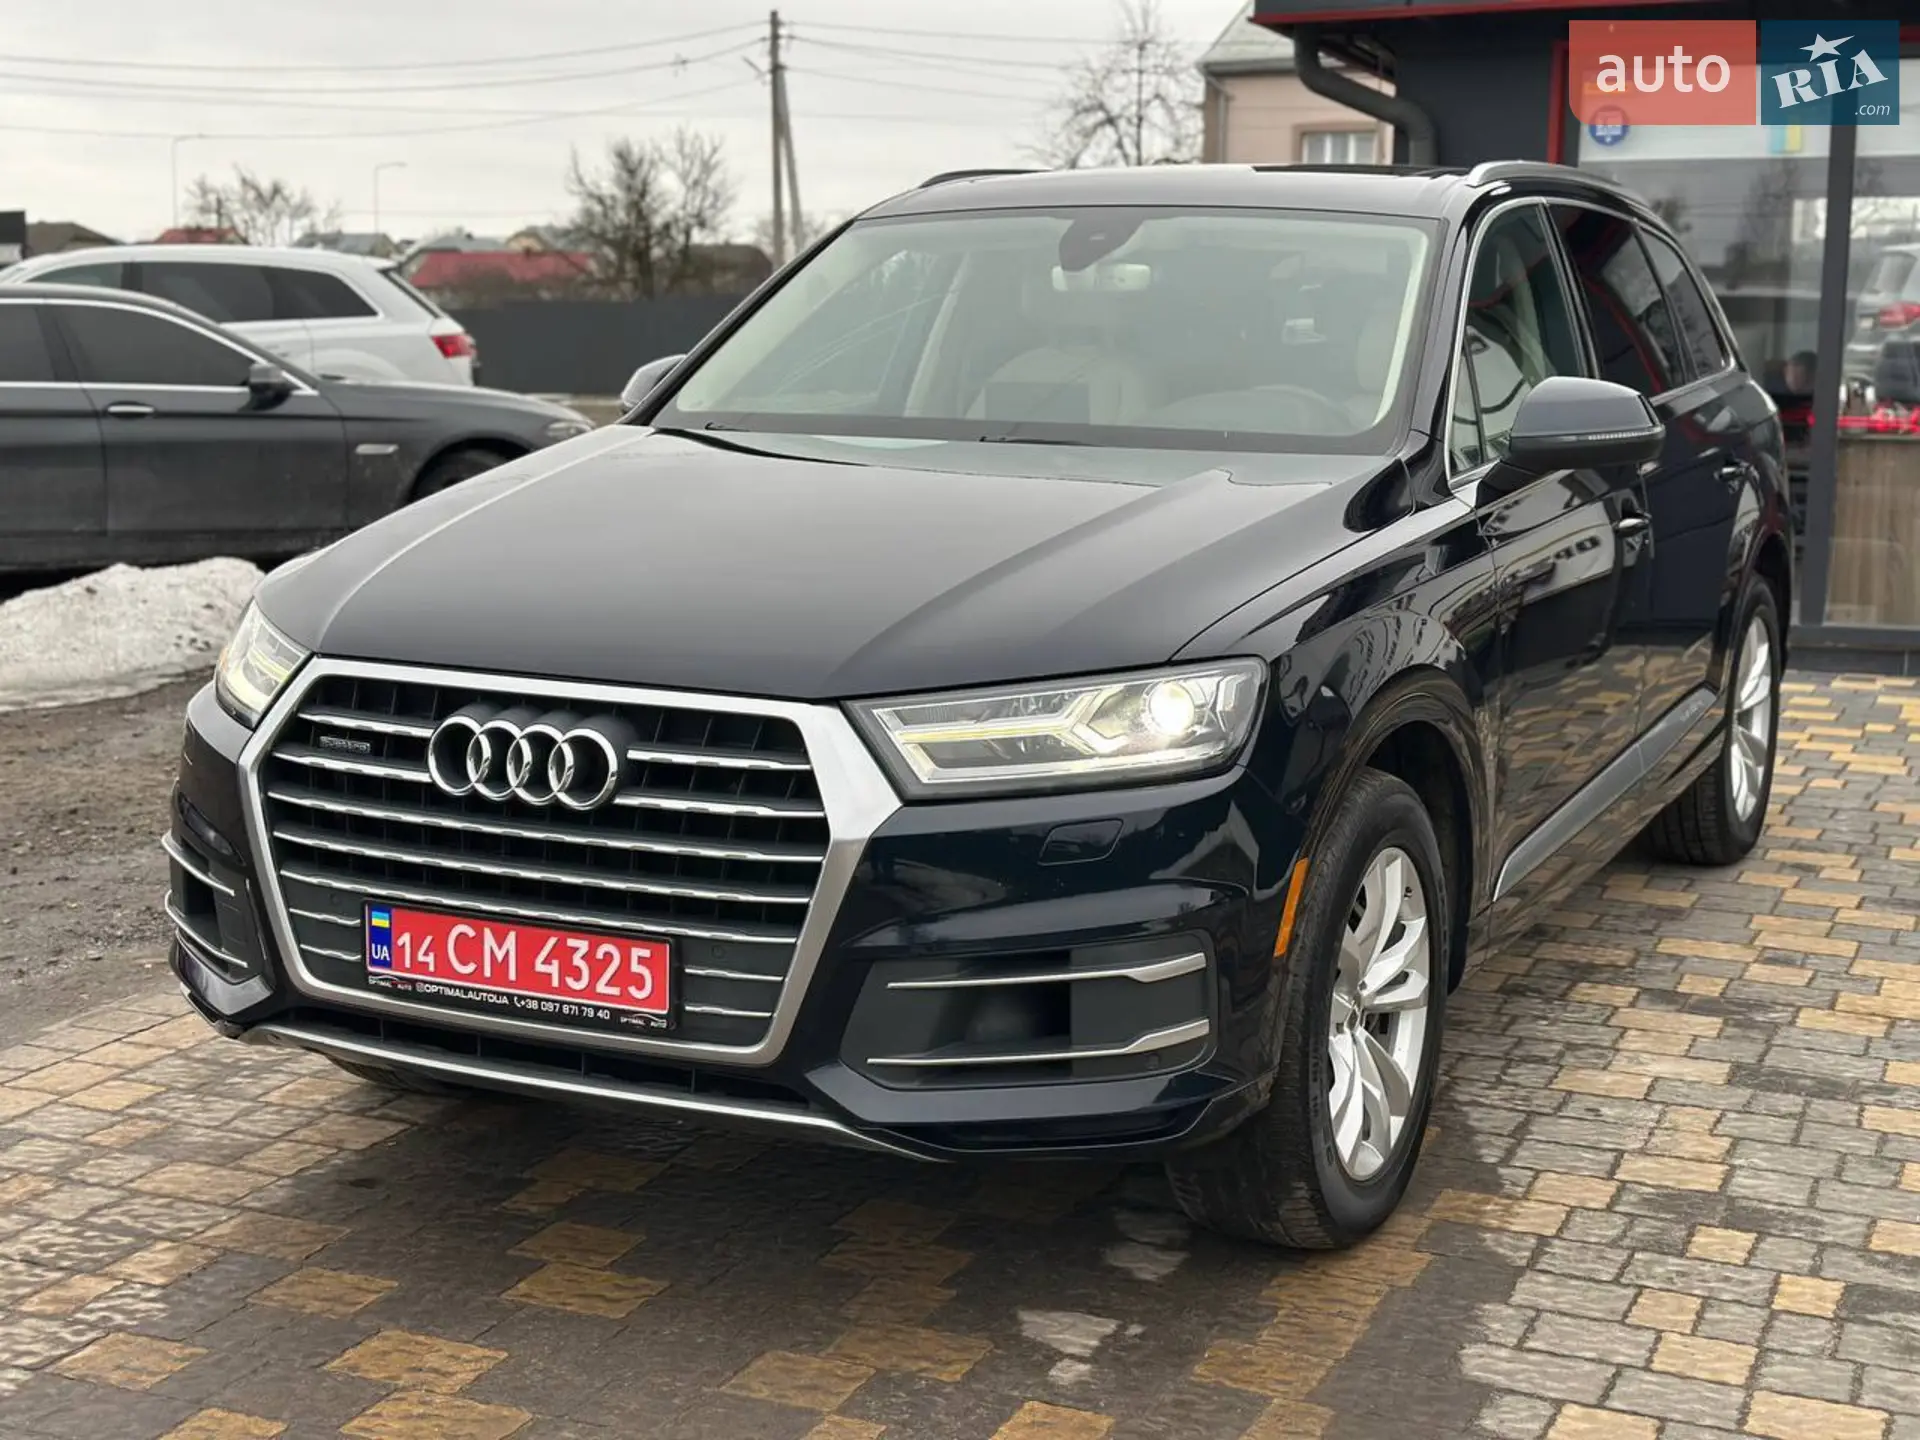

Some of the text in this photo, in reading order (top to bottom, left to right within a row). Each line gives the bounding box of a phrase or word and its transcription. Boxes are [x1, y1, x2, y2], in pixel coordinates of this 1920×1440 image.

[371, 943, 391, 961] UA
[396, 923, 653, 1000] 14 CM 4325
[520, 998, 611, 1019] +38 097 871 79 40
